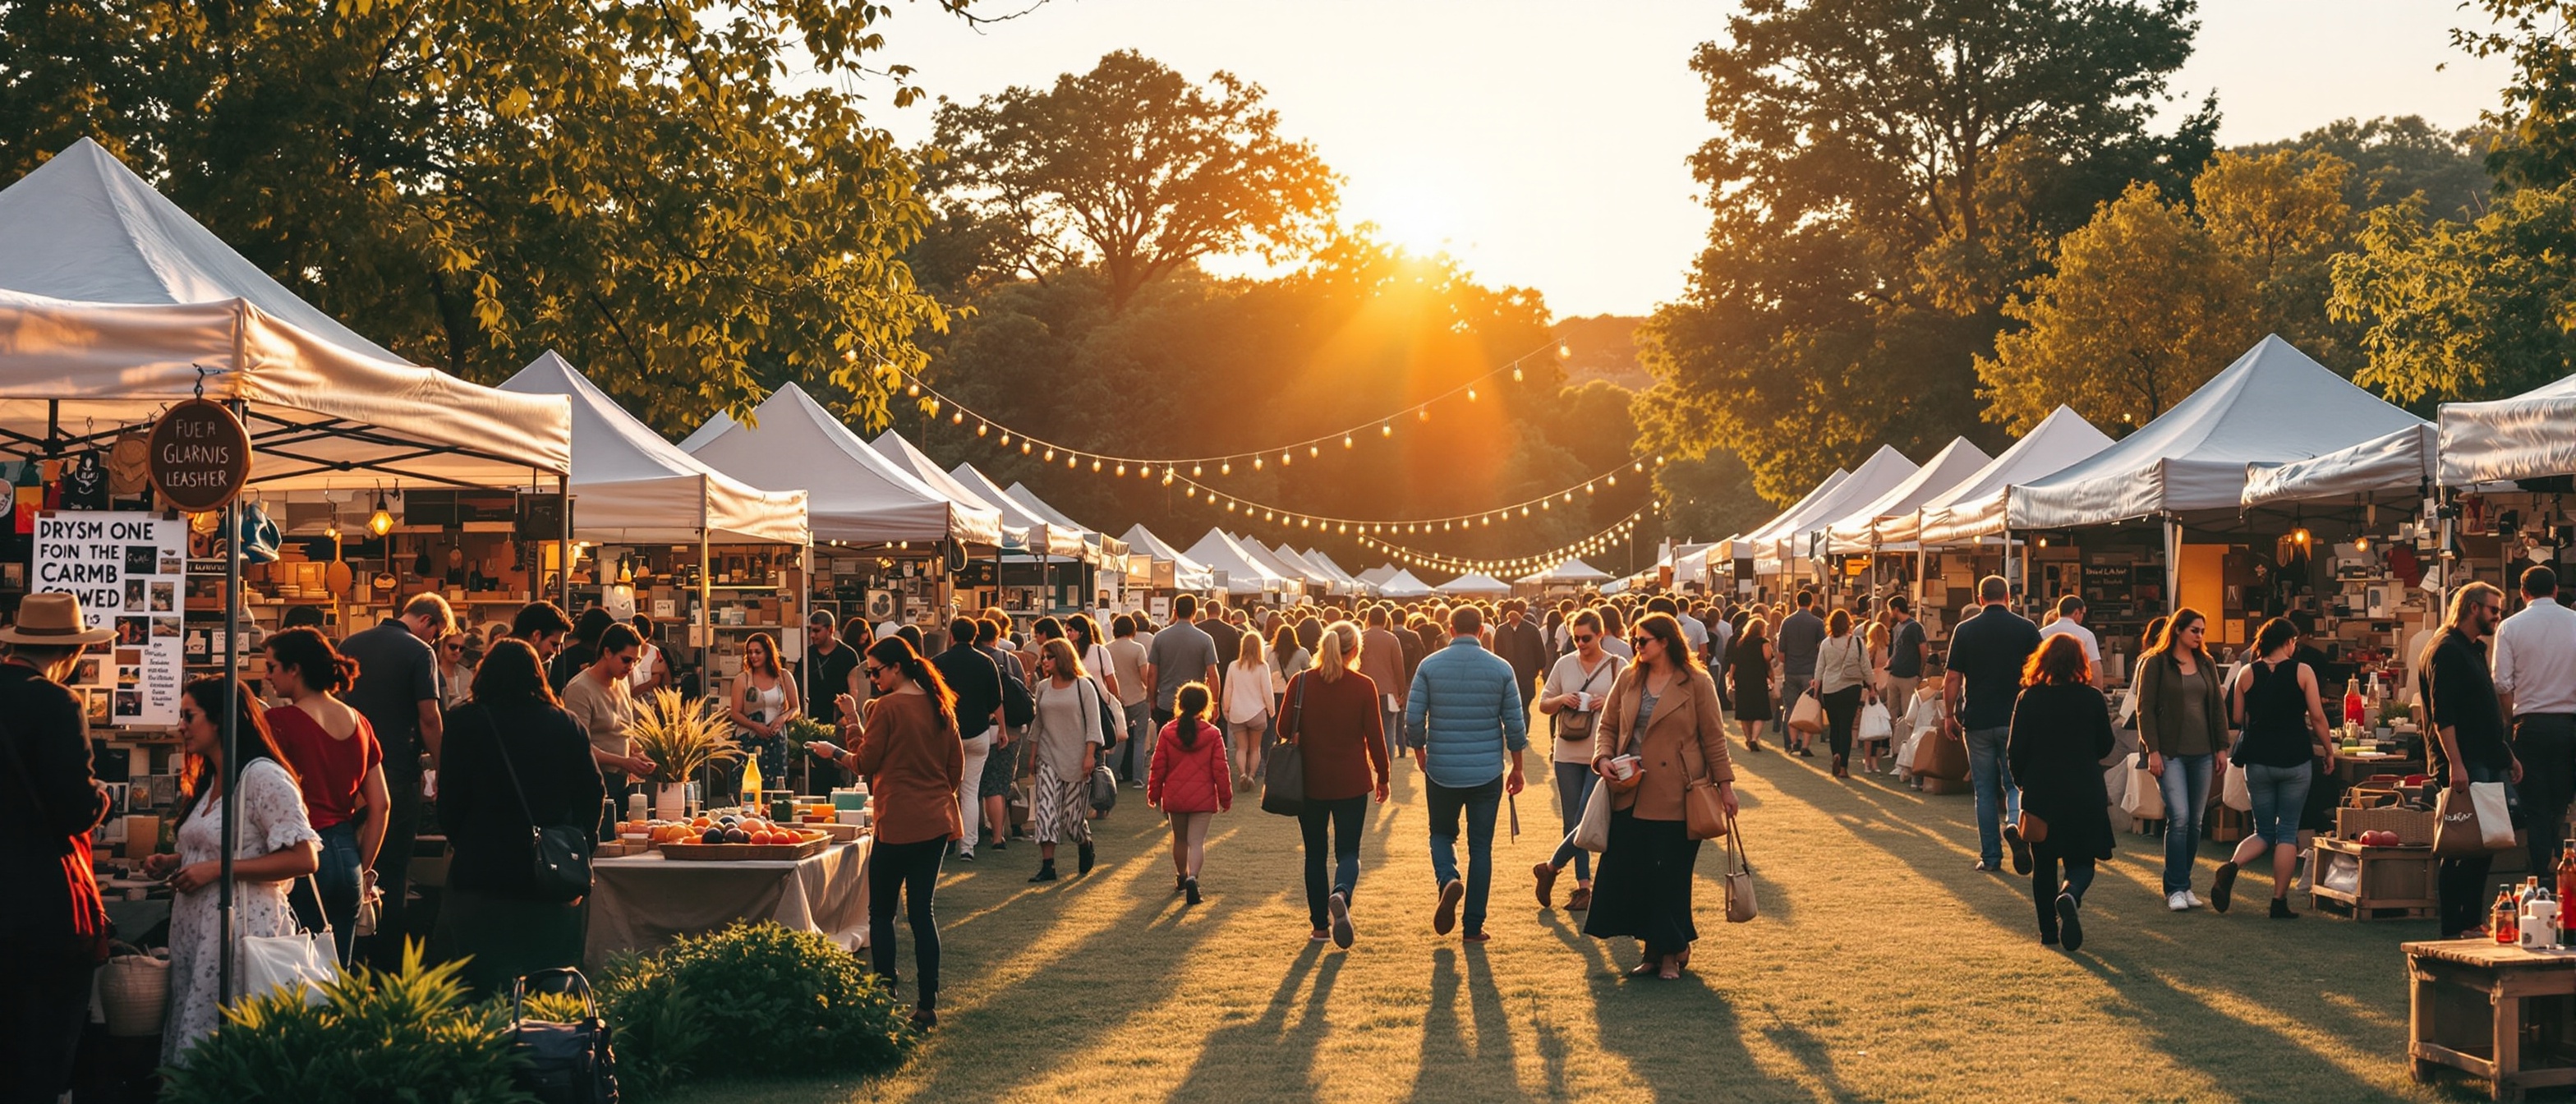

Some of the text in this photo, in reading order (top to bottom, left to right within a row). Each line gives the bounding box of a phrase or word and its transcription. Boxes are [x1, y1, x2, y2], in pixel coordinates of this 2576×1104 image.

[163, 443, 229, 464] GLARNIS
[166, 469, 227, 488] LEASHER
[39, 520, 154, 540] DRYSM ONE
[40, 543, 80, 559] FOIN
[89, 545, 120, 560] THE
[40, 562, 117, 584] CARMB
